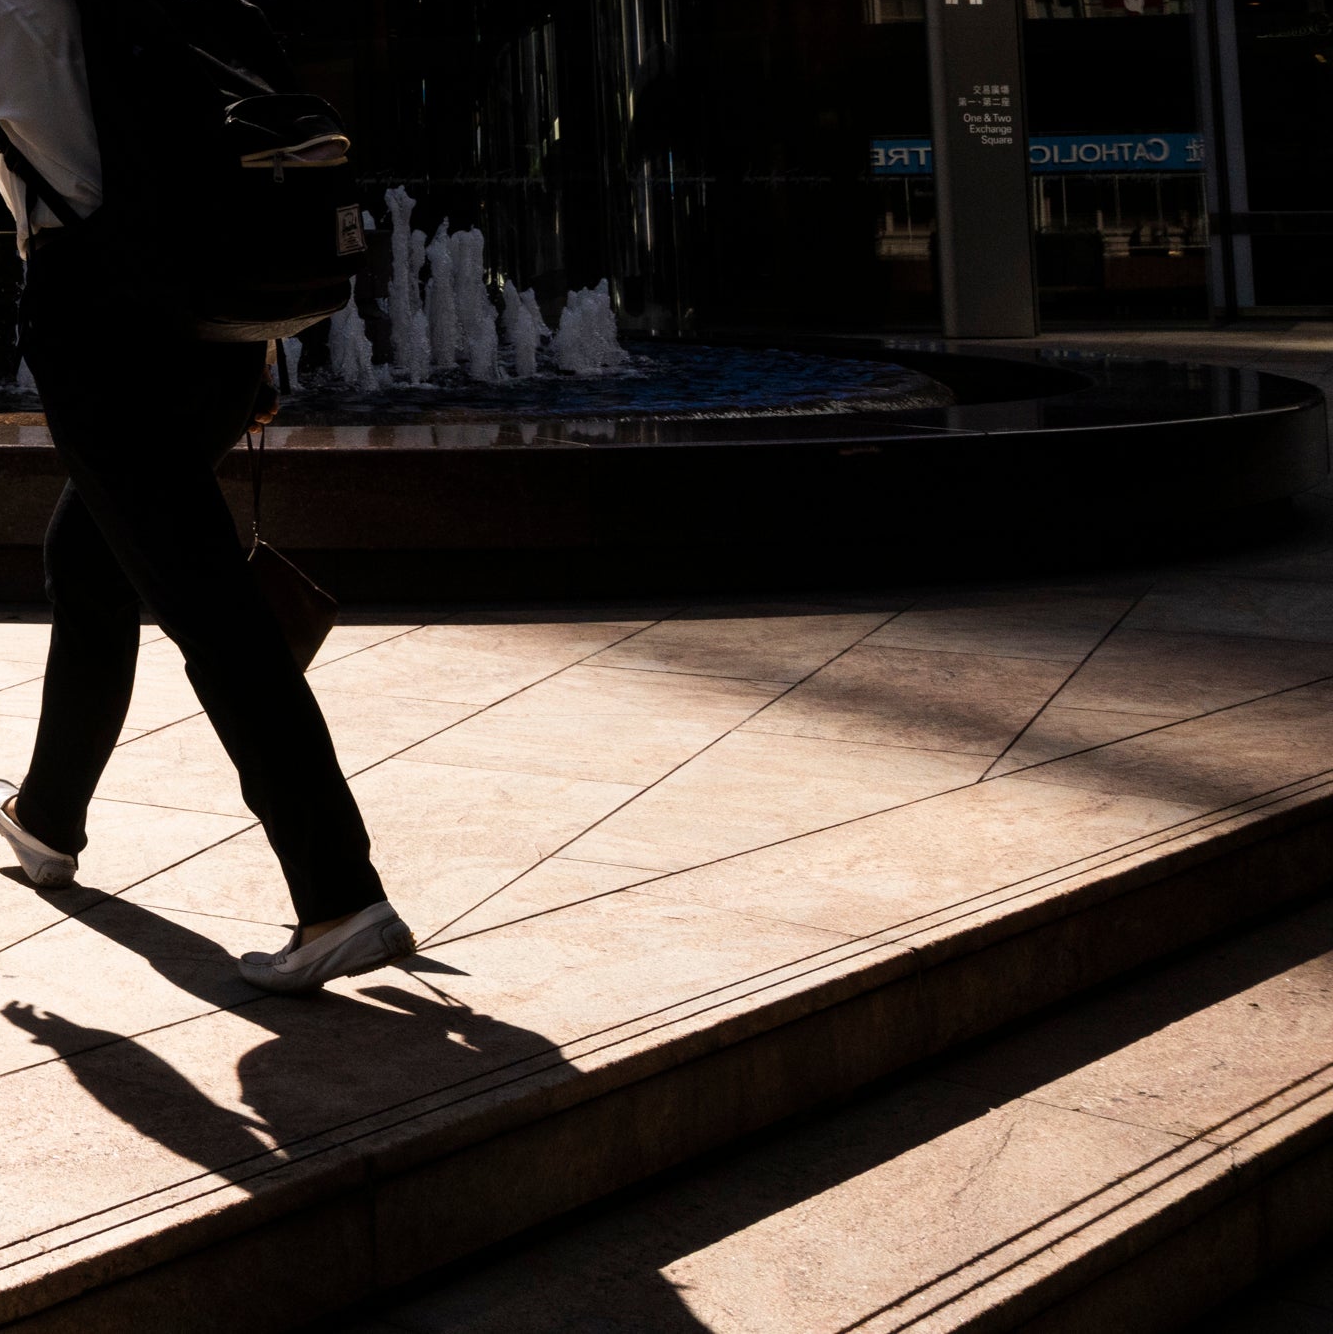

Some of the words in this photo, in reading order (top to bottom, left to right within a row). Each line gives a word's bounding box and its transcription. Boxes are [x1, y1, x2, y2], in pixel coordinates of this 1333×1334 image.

[963, 113, 982, 123] One
[992, 113, 1012, 123] Two
[969, 124, 1012, 136] Exchange
[981, 135, 1013, 146] Square
